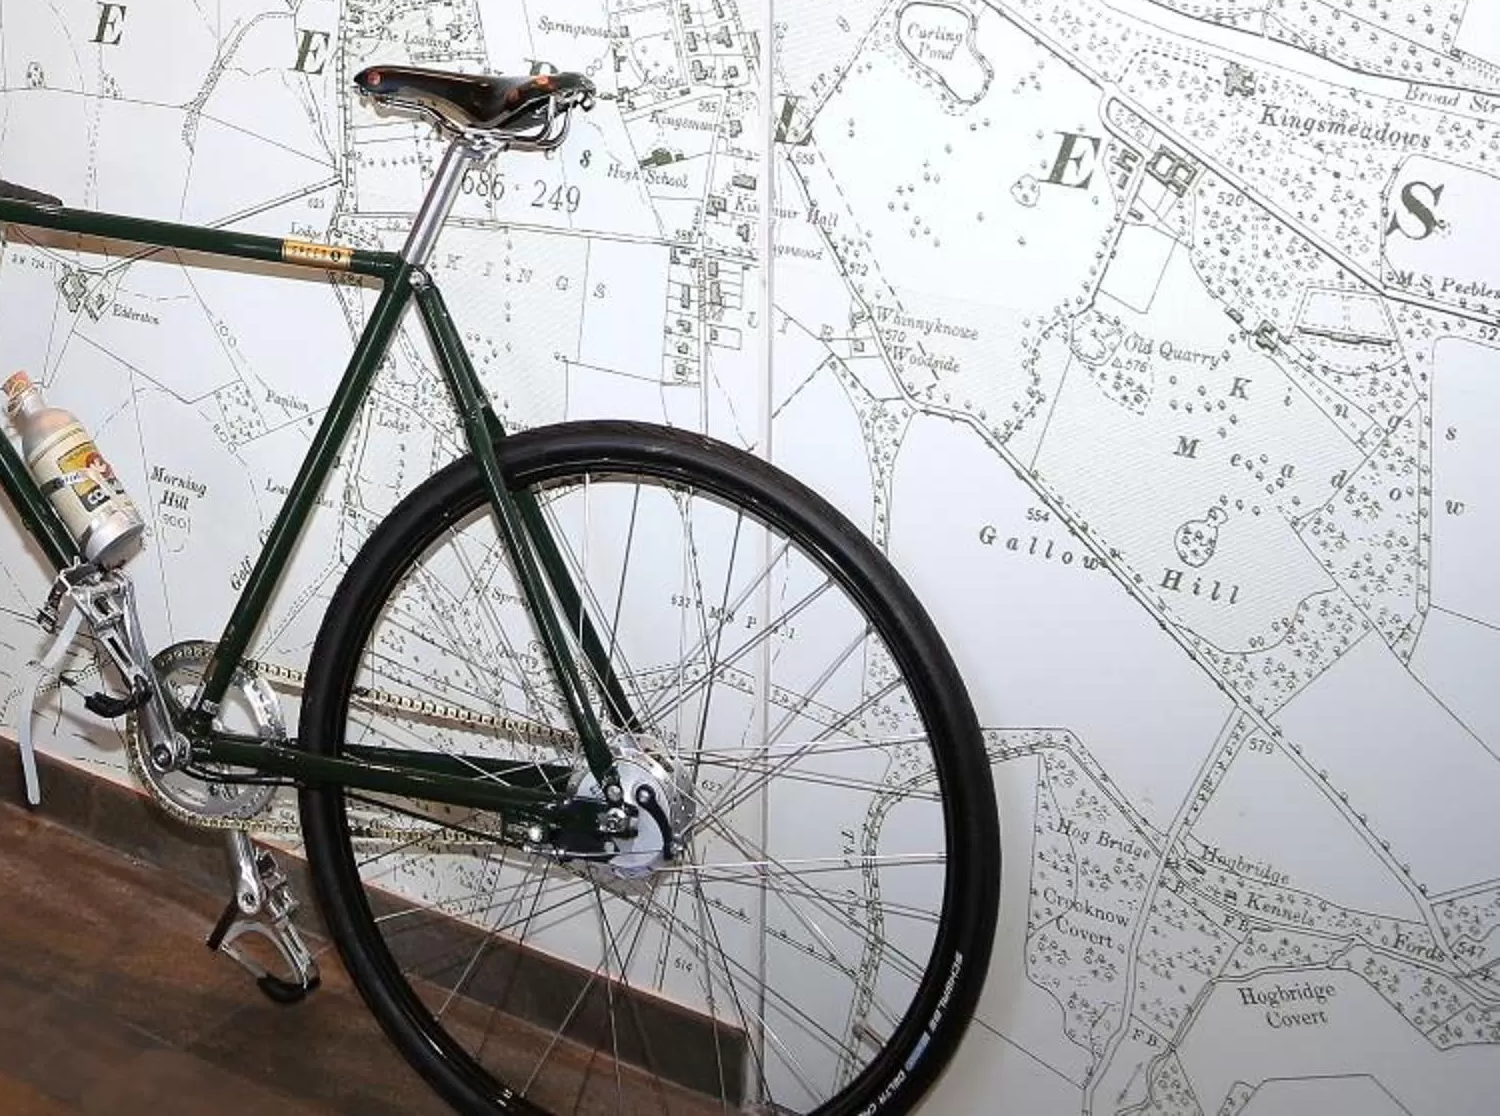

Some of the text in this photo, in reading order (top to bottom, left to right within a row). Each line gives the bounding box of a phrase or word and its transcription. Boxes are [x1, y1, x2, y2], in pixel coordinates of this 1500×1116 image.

[906, 21, 964, 45] Curling
[1405, 82, 1458, 107] Broad
[1256, 104, 1432, 150] Kingsmeadows
[607, 161, 689, 189] High School
[530, 179, 581, 214] 249
[1442, 277, 1500, 299] Peebles
[876, 305, 979, 341] Whinnyknowe
[891, 345, 961, 374] Woodside
[1123, 335, 1222, 371] Old Quarry
[148, 465, 208, 499] Morning
[161, 489, 191, 511] Hill
[231, 554, 255, 592] Golf
[1159, 567, 1240, 606] Hill
[1248, 736, 1275, 755] 579
[1056, 816, 1151, 860] Hog Bridge
[1198, 844, 1290, 884] Hogbridge
[1246, 893, 1315, 927] Kennels
[1055, 912, 1115, 950] Covert
[1237, 981, 1337, 1008] Hogbridge
[1264, 1009, 1329, 1030] Covert
